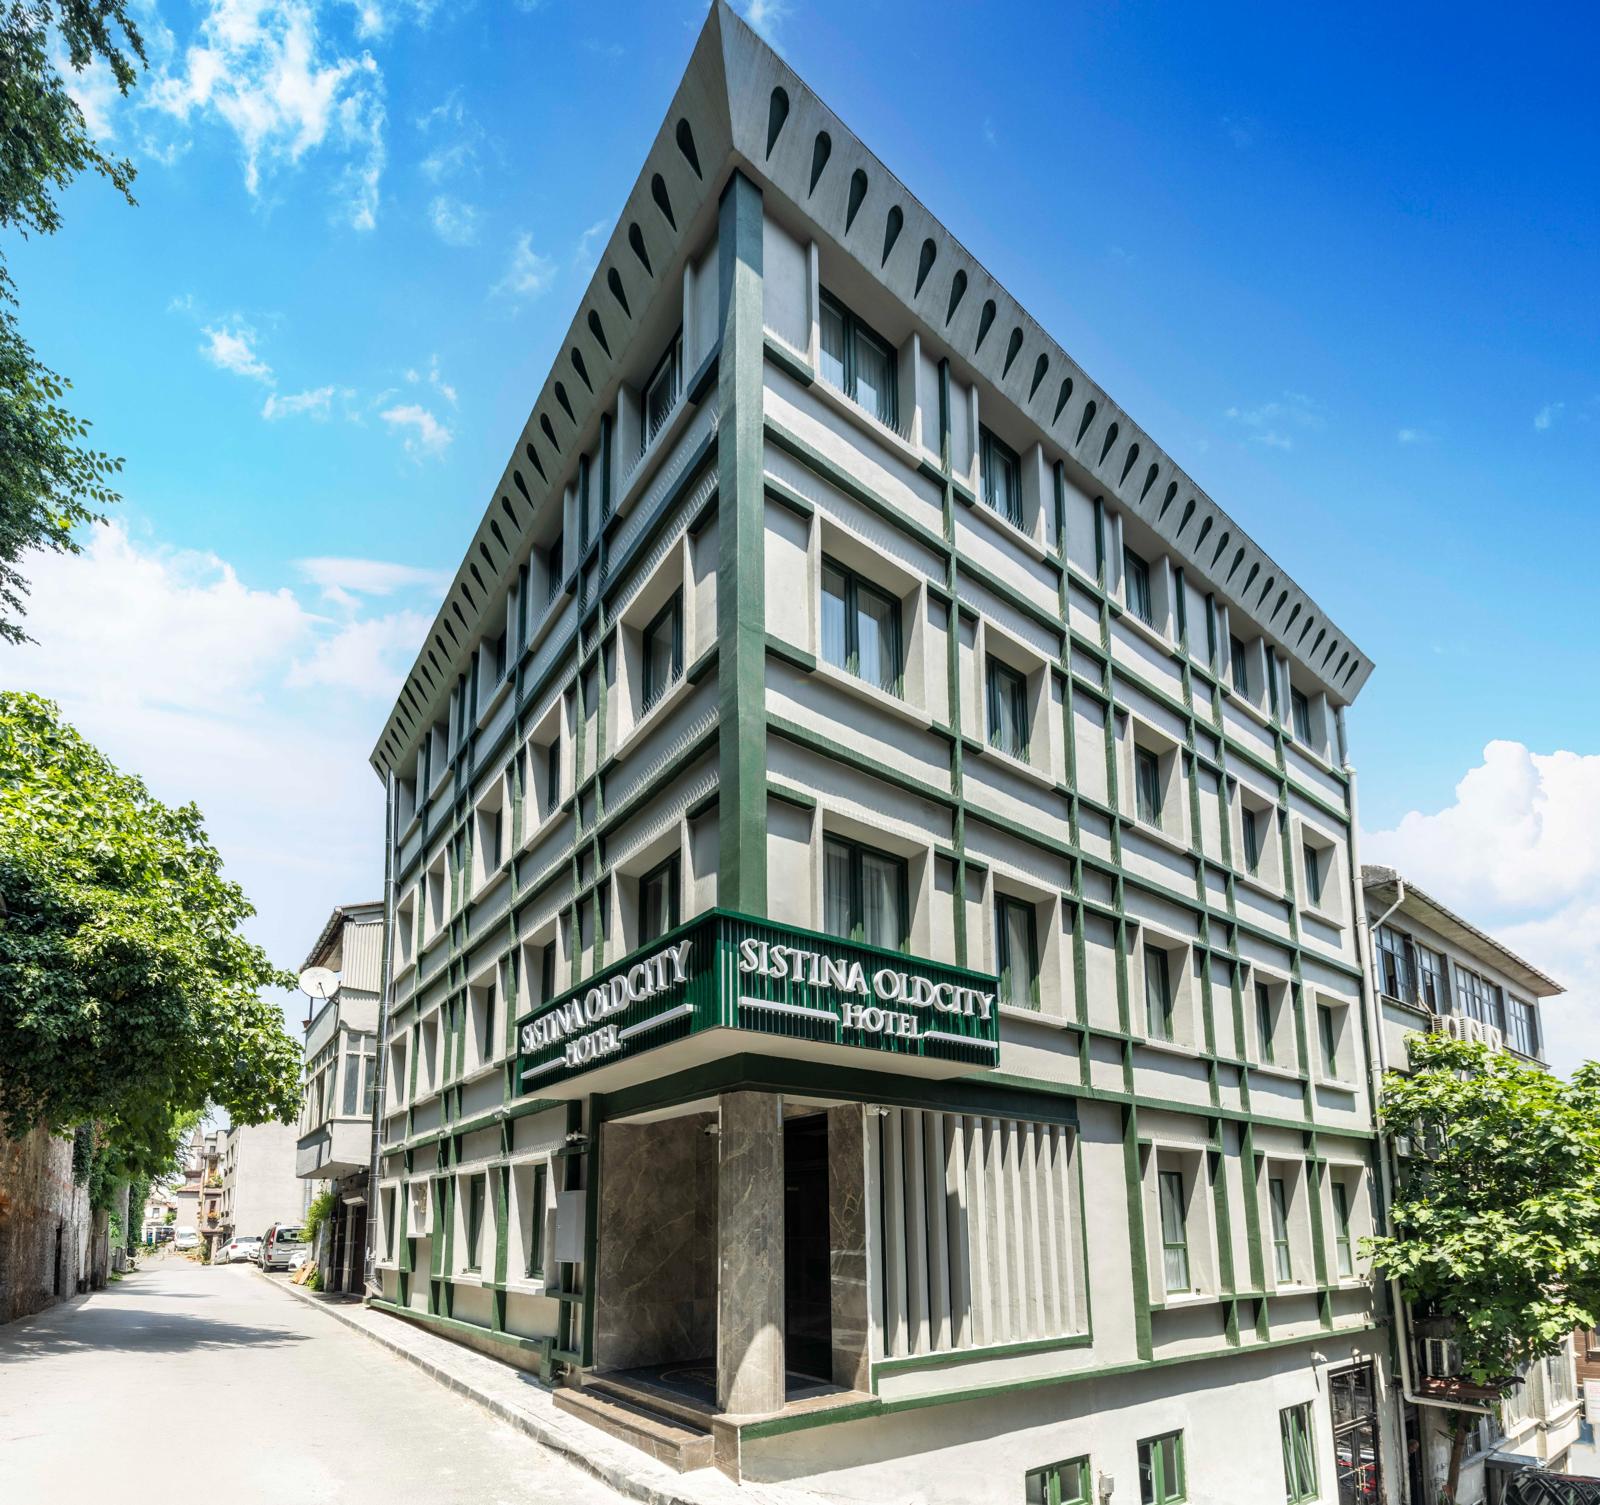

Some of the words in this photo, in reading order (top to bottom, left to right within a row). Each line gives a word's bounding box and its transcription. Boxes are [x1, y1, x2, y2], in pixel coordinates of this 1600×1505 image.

[521, 998, 587, 1054] SISTINA
[585, 940, 693, 1022] OLDCITY
[740, 938, 870, 995] SISTINA
[874, 969, 995, 1020] OLDCITY
[565, 1024, 621, 1068] HOTEL
[841, 1003, 924, 1039] HOTEL
